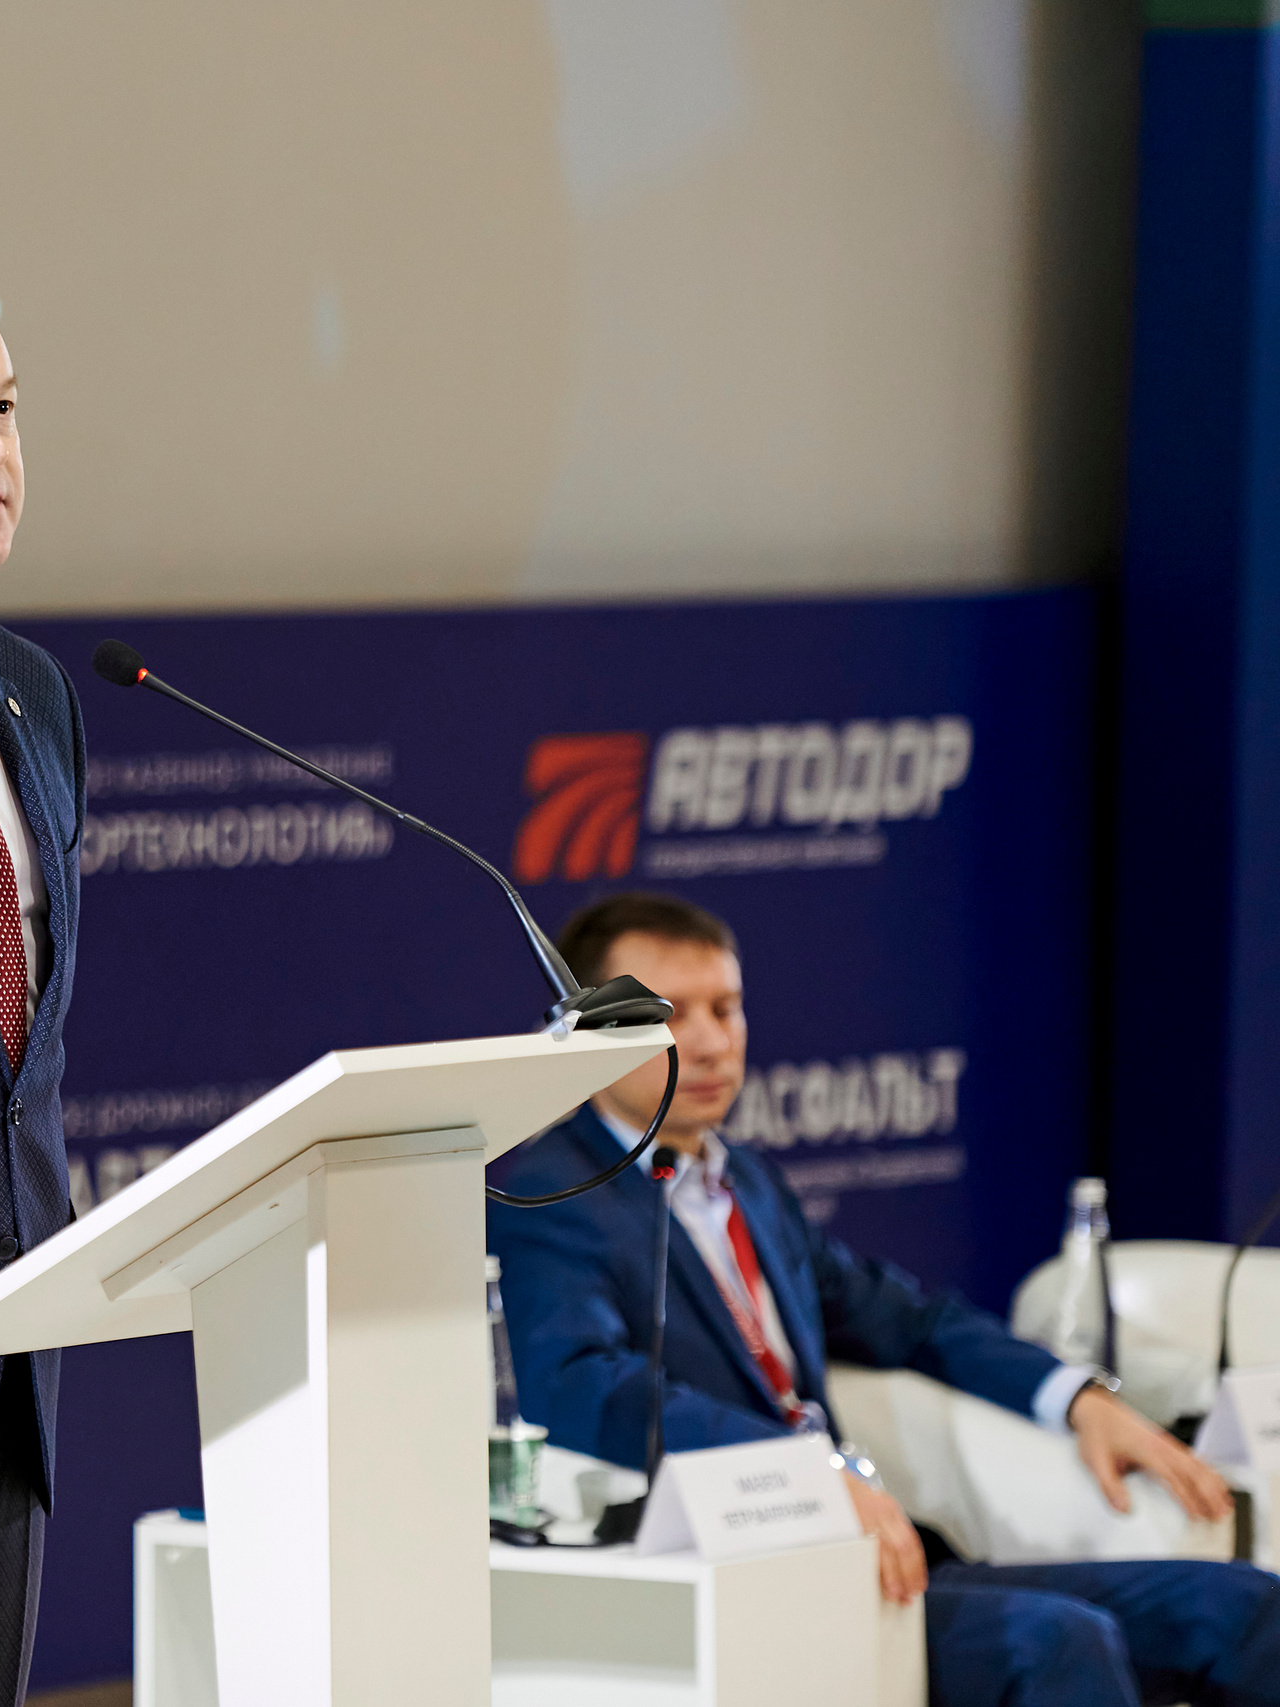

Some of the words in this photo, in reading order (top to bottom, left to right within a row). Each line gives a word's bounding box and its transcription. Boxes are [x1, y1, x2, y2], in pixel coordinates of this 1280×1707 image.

[650, 716, 972, 831] АВТОДОР
[82, 803, 394, 875] ОРТЕХНОЛОГИЯ»
[724, 1050, 963, 1147] АСФАЛЬТ
